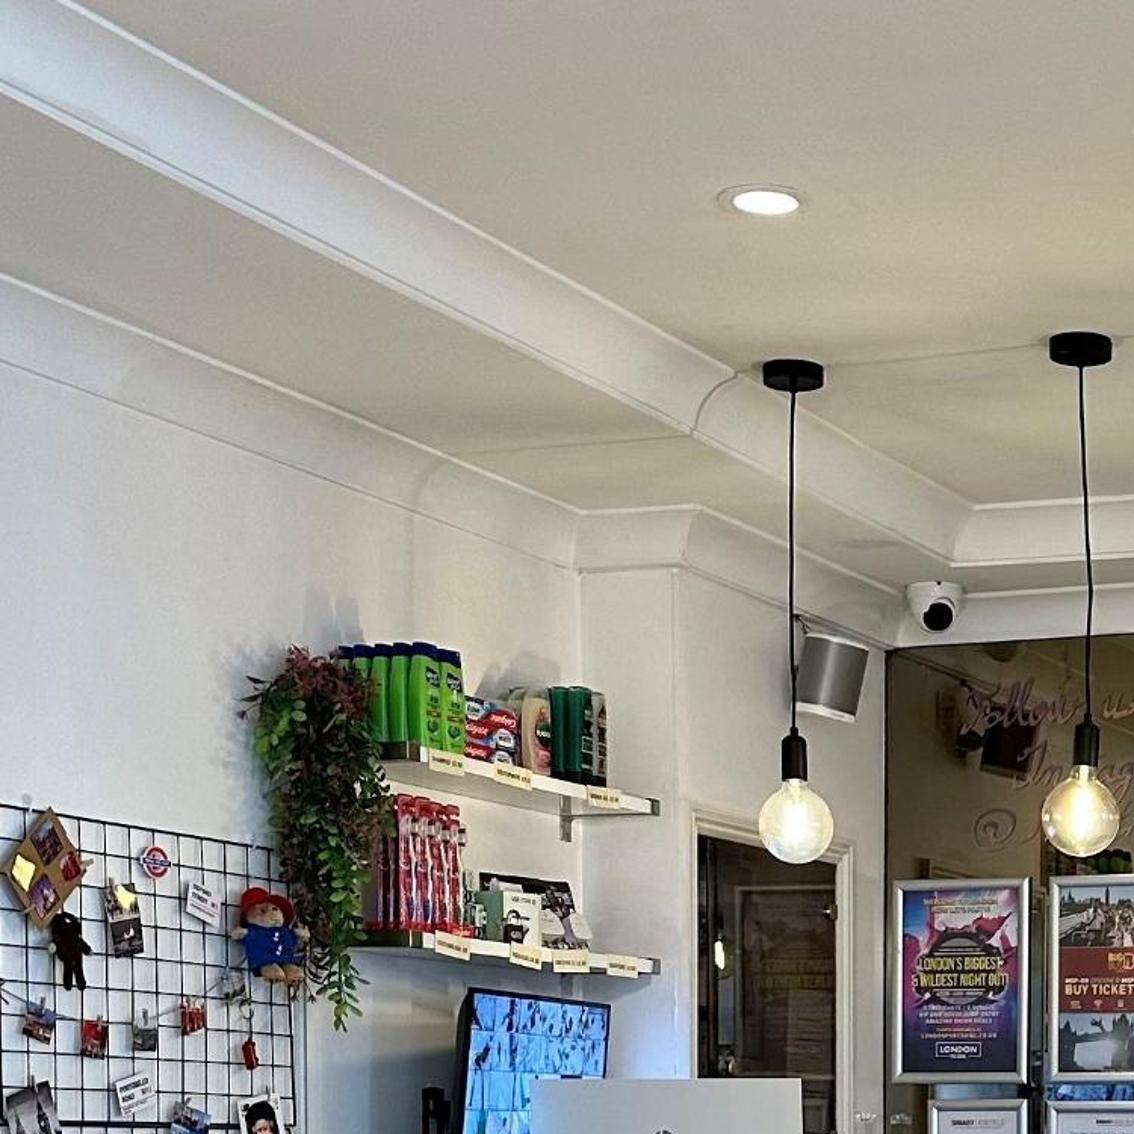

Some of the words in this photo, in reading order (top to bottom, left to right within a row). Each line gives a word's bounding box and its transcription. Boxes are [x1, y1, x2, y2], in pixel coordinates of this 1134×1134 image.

[920, 973, 958, 987] WILDEST
[960, 973, 986, 986] NIGHT
[1065, 984, 1089, 995] BUY
[940, 1045, 977, 1054] LONDON
